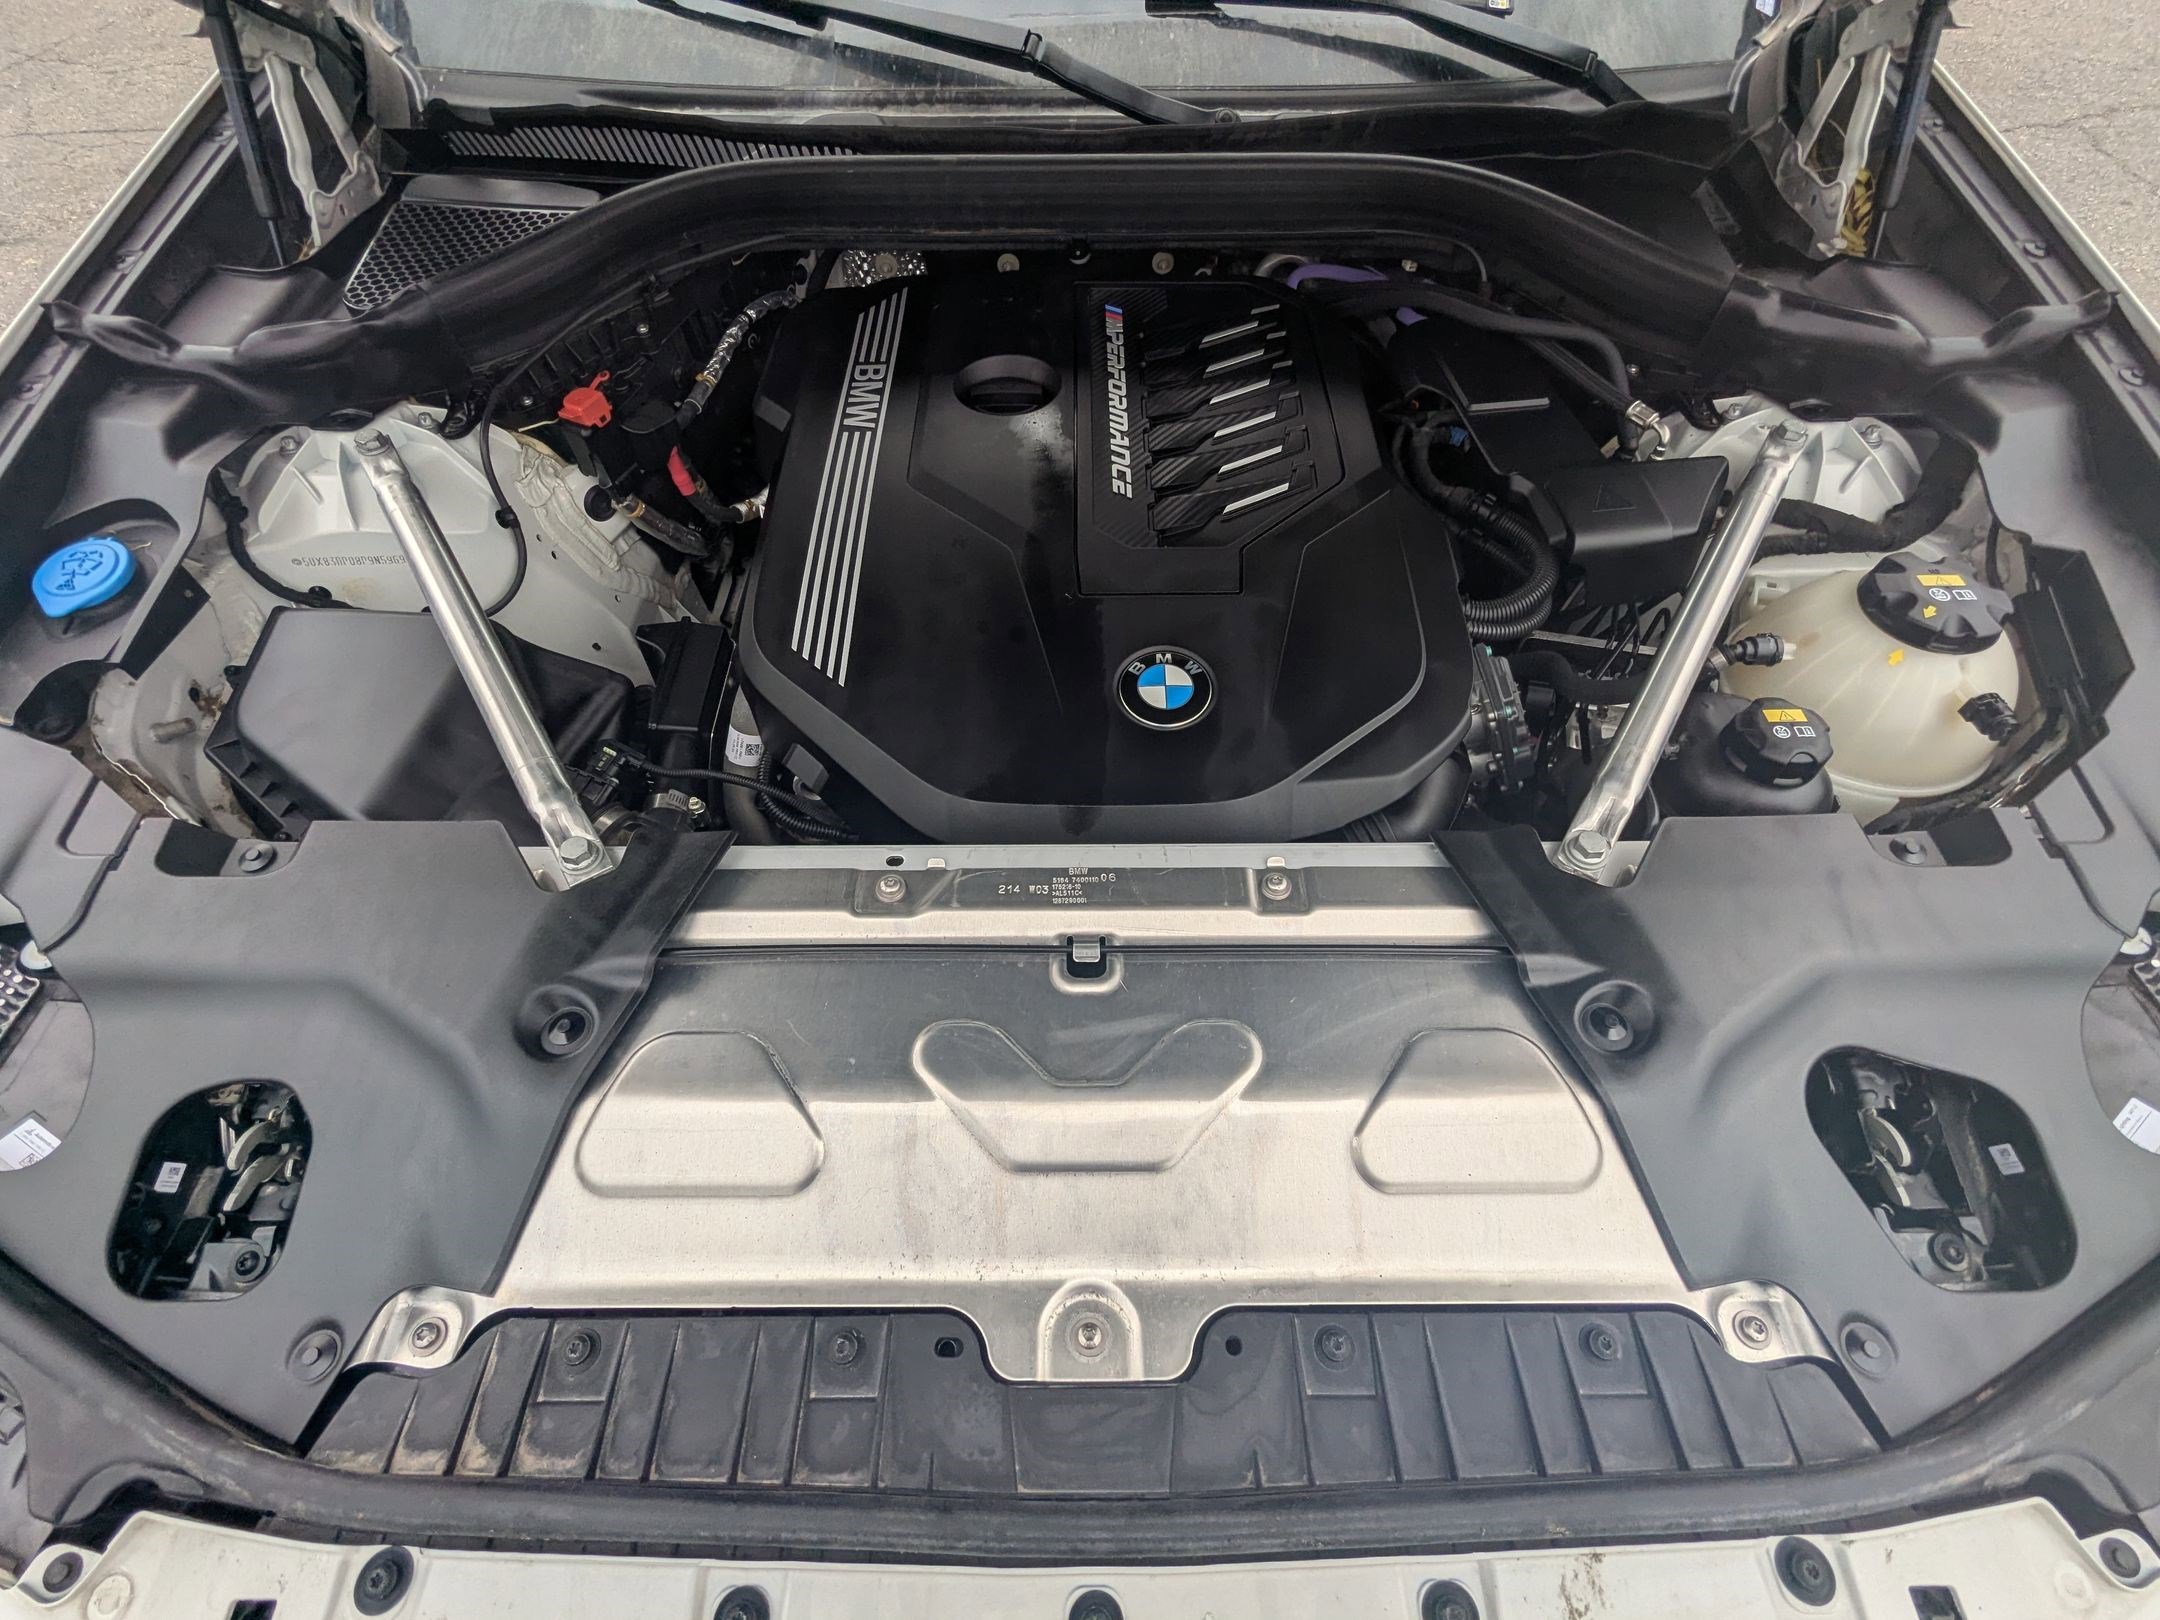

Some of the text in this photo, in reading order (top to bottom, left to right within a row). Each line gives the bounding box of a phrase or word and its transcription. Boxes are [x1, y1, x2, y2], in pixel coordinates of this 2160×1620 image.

[843, 363, 888, 430] BMW
[1128, 651, 1203, 677] BMW
[1068, 867, 1089, 876] BMW
[1100, 873, 1117, 882] 06
[998, 884, 1050, 895] 214 W03
